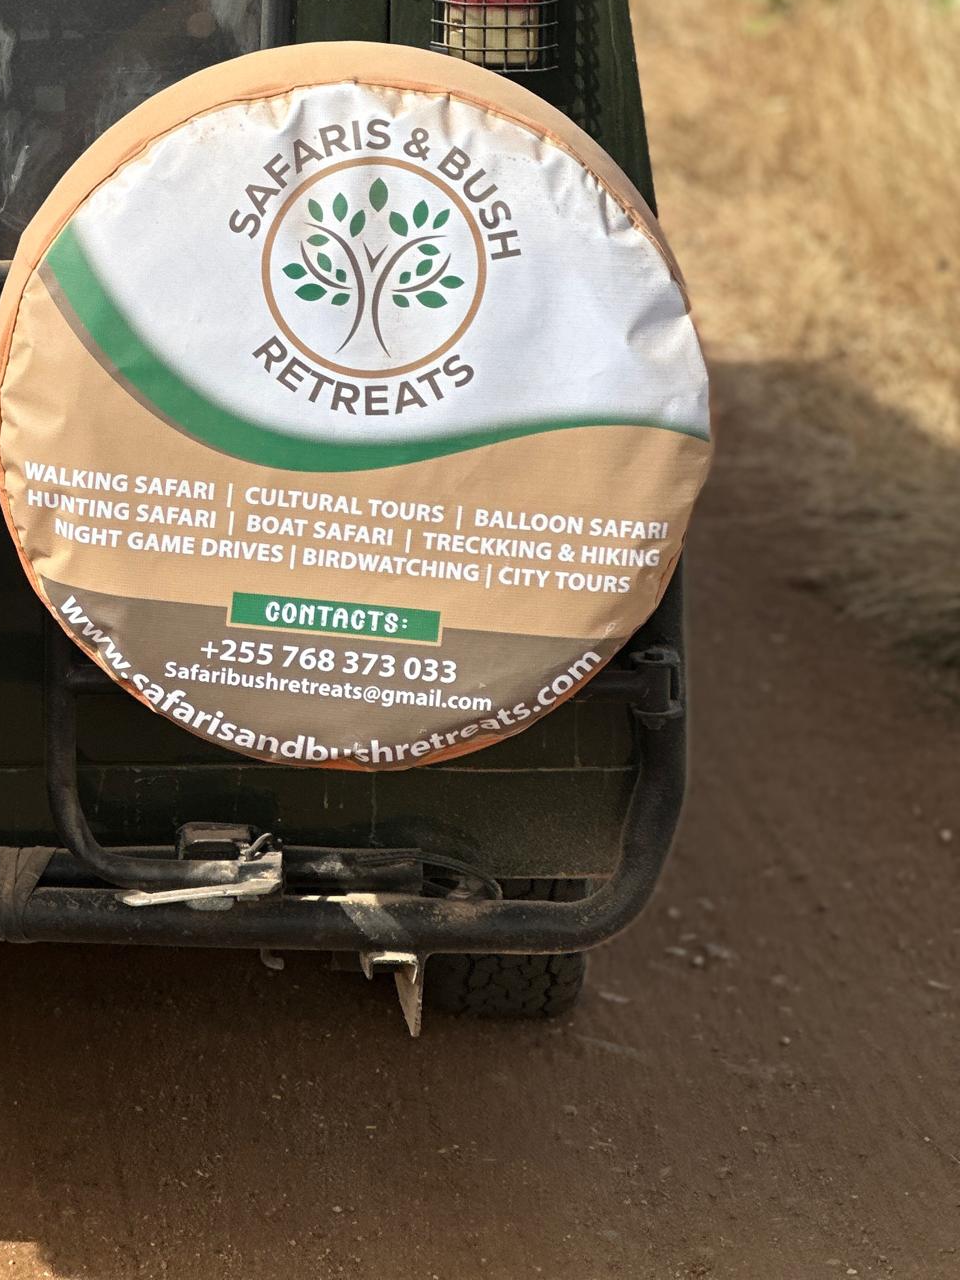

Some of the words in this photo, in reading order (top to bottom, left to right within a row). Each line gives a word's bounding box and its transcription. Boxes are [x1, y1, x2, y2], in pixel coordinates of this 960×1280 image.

[228, 119, 392, 239] SAFARIS
[403, 127, 431, 162] &
[437, 146, 522, 260] BUSH
[251, 335, 475, 416] RETREATS
[24, 461, 129, 492] WALKING
[134, 475, 215, 501] SAFARI
[244, 486, 362, 516] CULTURAL
[368, 498, 445, 524] TOURS
[474, 508, 584, 535] BALLOON
[589, 518, 669, 540] SAFARI
[27, 489, 130, 521] HUNTING
[135, 503, 217, 529] SAFARI
[246, 514, 309, 538] BOAT
[312, 521, 394, 546] SAFARI
[422, 531, 552, 561] TRECKKING
[557, 543, 576, 563] &
[580, 545, 661, 567] HIKING
[54, 517, 122, 548] NIGHT
[127, 531, 195, 555] GAME
[201, 538, 284, 563] DRIVES
[302, 547, 480, 582] BIRDWATCHING
[498, 566, 549, 589] CITY
[555, 571, 632, 594] TOURS
[264, 601, 409, 634] CONTACTS:
[164, 661, 493, 712] Safaribushretreats@gmail.com
[200, 639, 273, 665] +255
[282, 645, 335, 672] 768
[342, 651, 396, 677] 373
[403, 657, 457, 684] 033
